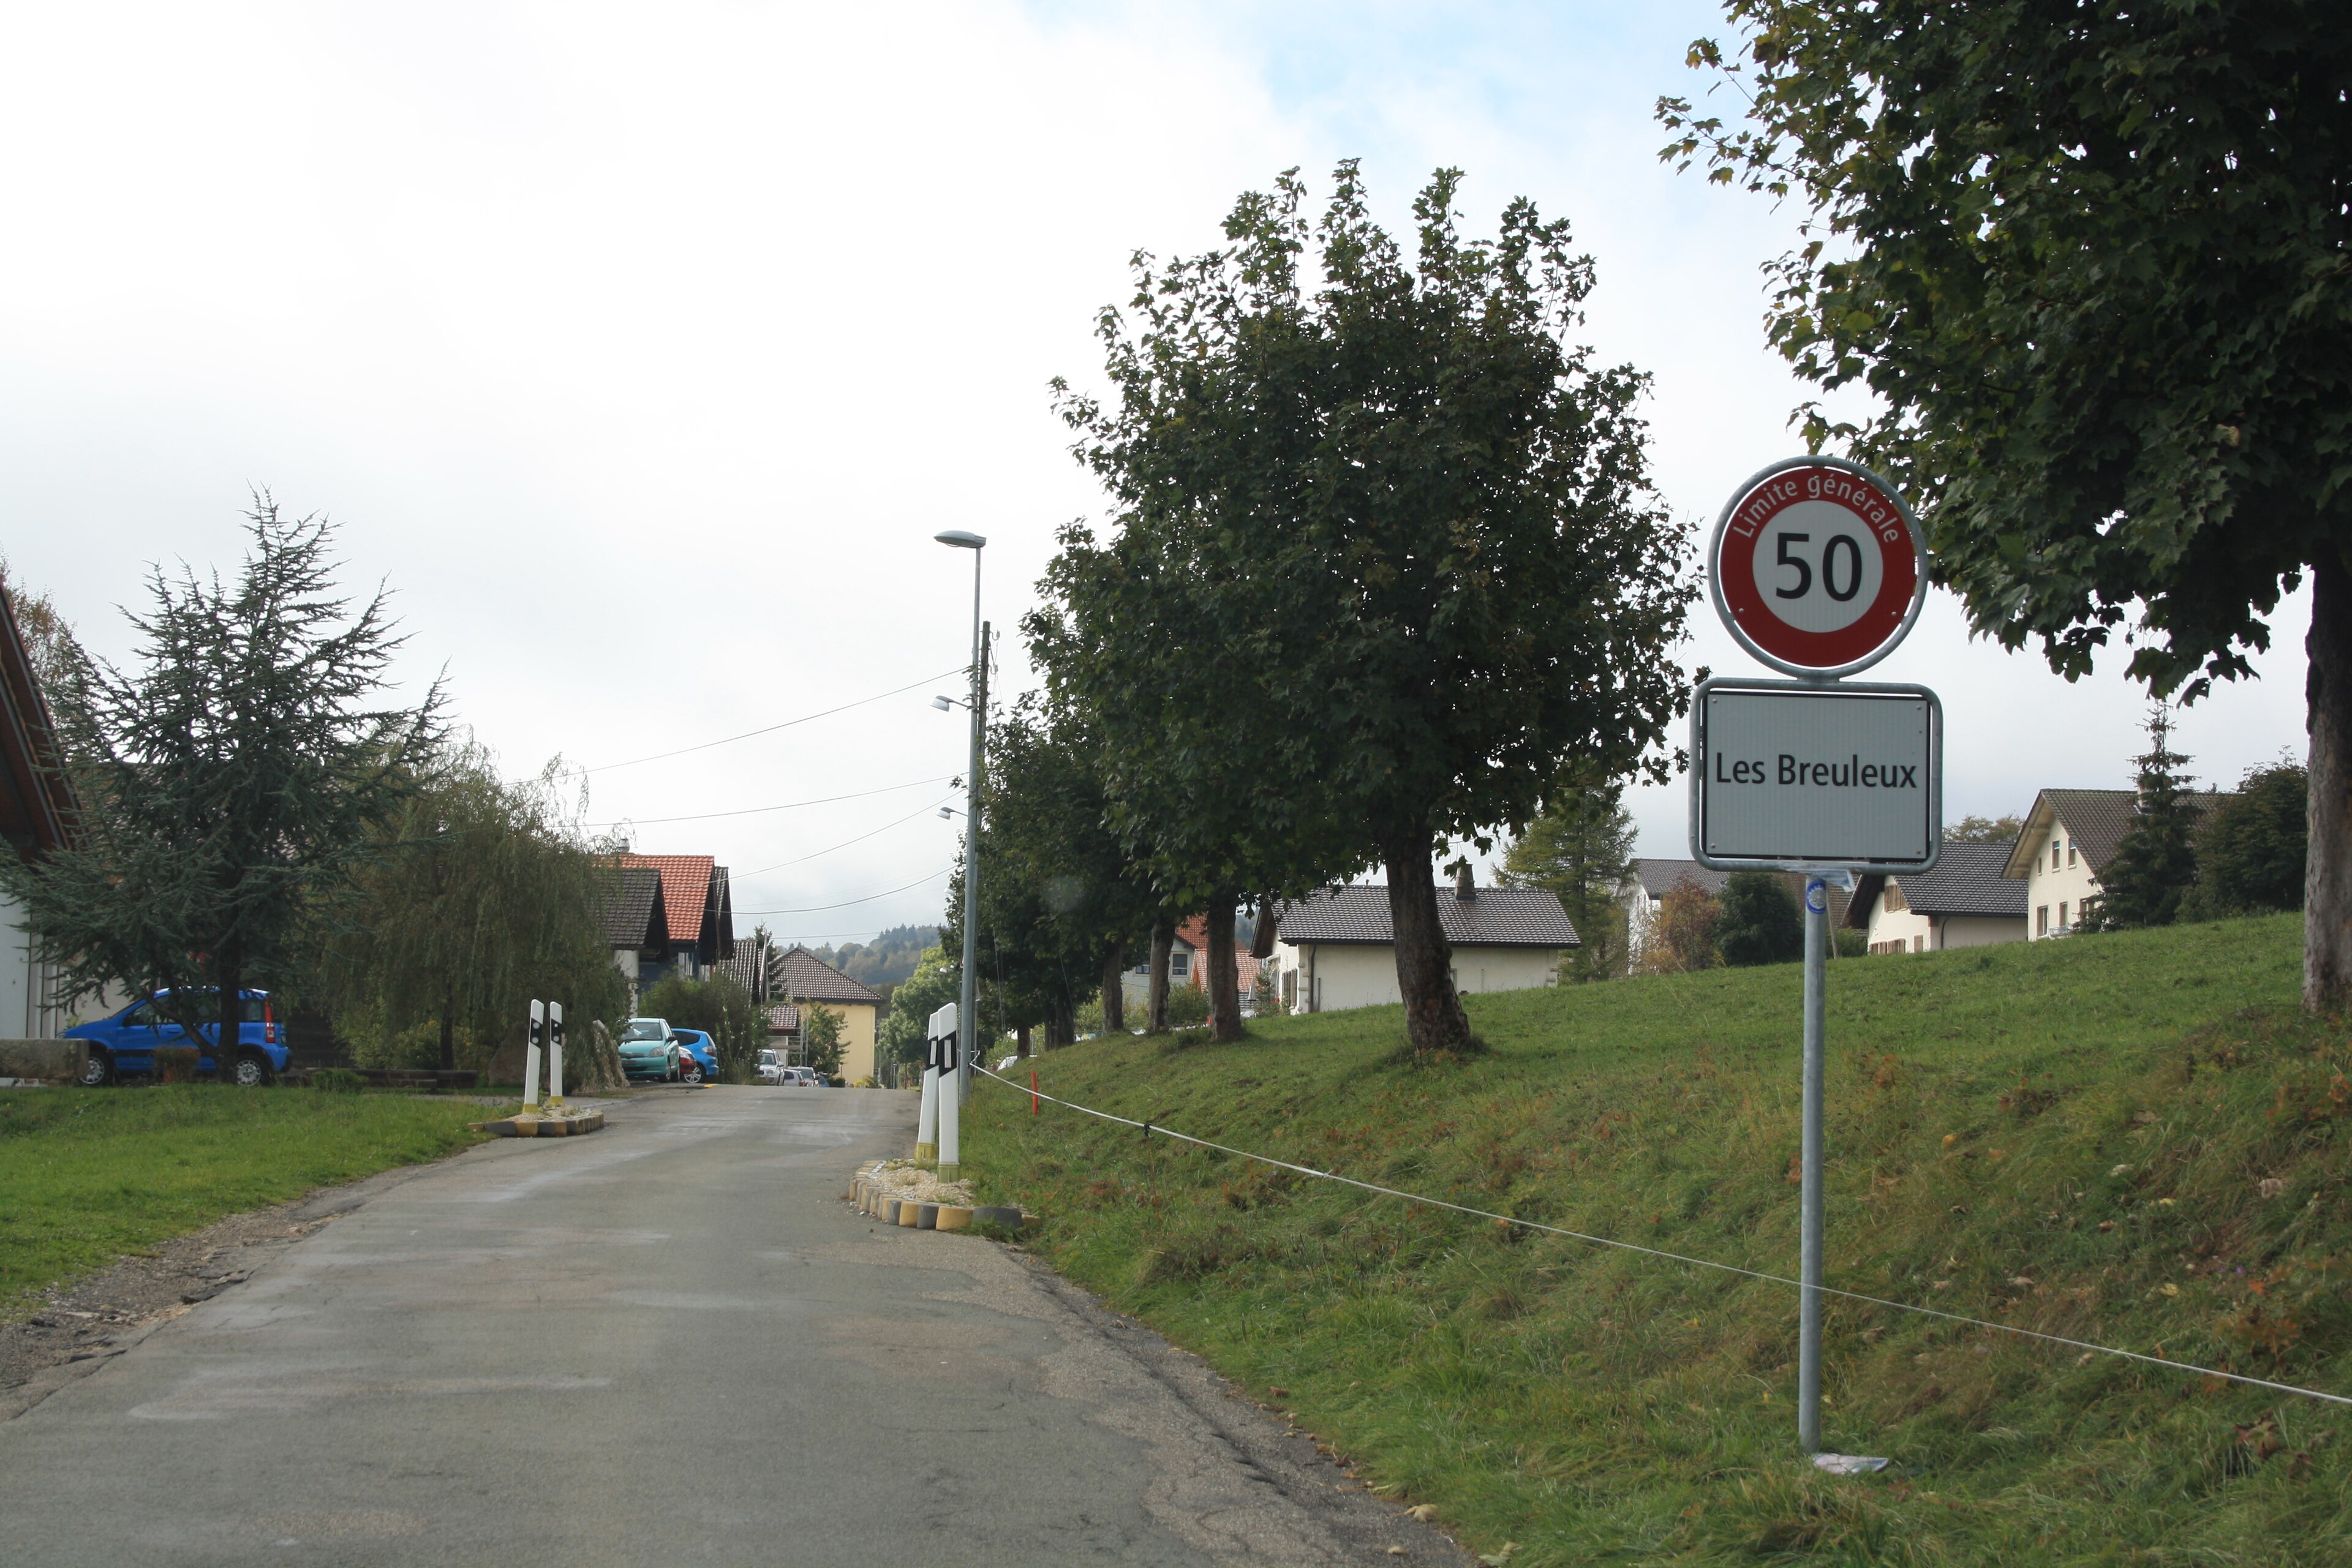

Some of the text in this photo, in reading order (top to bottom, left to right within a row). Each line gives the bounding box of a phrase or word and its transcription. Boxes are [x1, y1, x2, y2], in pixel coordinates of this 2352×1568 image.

[1732, 473, 1899, 543] Limite générale
[1776, 532, 1863, 603] 50
[1716, 752, 1918, 789] Les Breuleux
